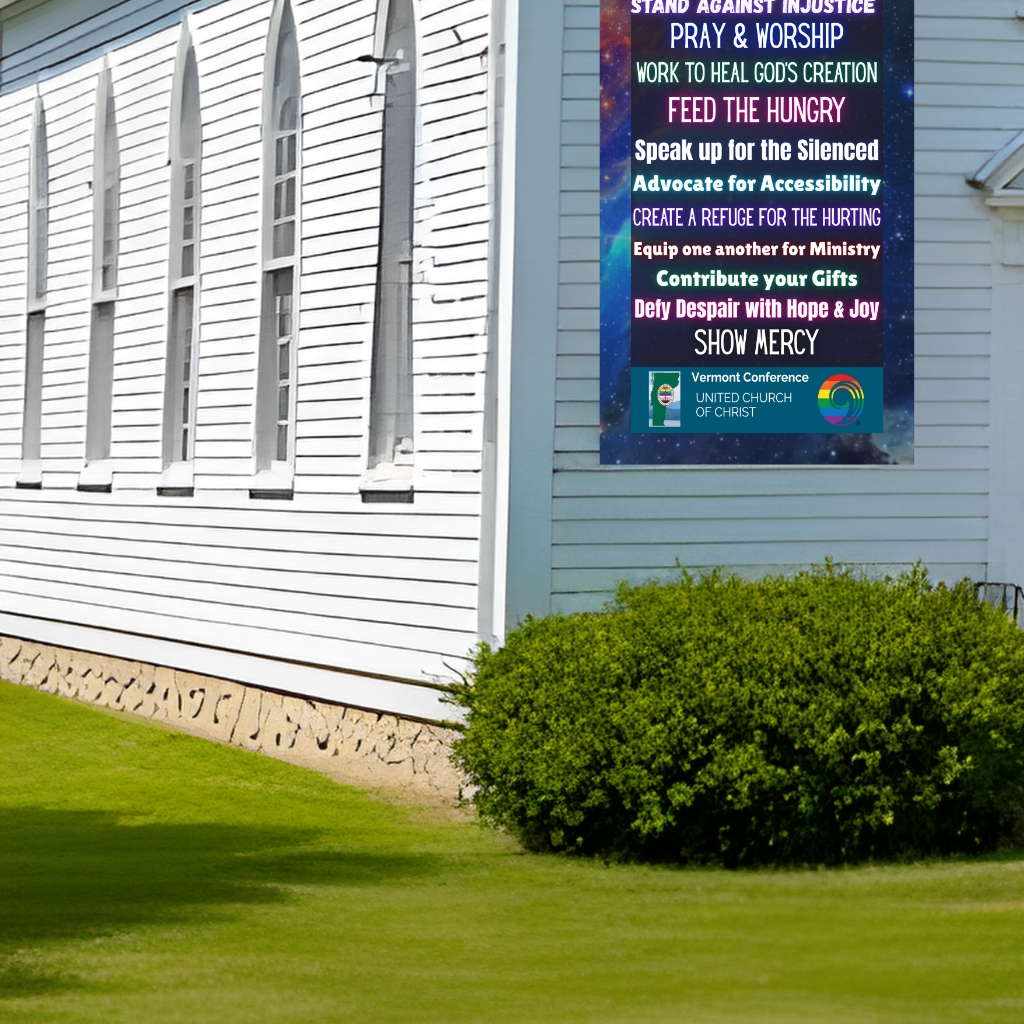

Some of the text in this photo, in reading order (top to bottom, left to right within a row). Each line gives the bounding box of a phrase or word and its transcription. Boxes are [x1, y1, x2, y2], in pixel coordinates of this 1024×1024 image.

[670, 22, 844, 49] PRAY & WORSHIP
[636, 61, 878, 84] WORK TO HEAL GOD'S CREATION
[668, 96, 846, 123] FEED THE HUNGRY
[634, 138, 879, 165] Speak up for the Silenced
[632, 174, 882, 196] Advocate for Accessibility
[632, 207, 882, 227] CREATE A REFUGE FOR THE HURTING
[633, 241, 881, 260] Equip one another for Ministry
[656, 269, 858, 291] Contribute your Gifts
[634, 297, 880, 322] Defy Despair with Hope & Joy
[694, 328, 820, 356] SHOW MERCY
[690, 371, 810, 383] Vermont Conference
[695, 392, 793, 403] UNITED CHURCH
[694, 406, 758, 418] OF CHRIST
